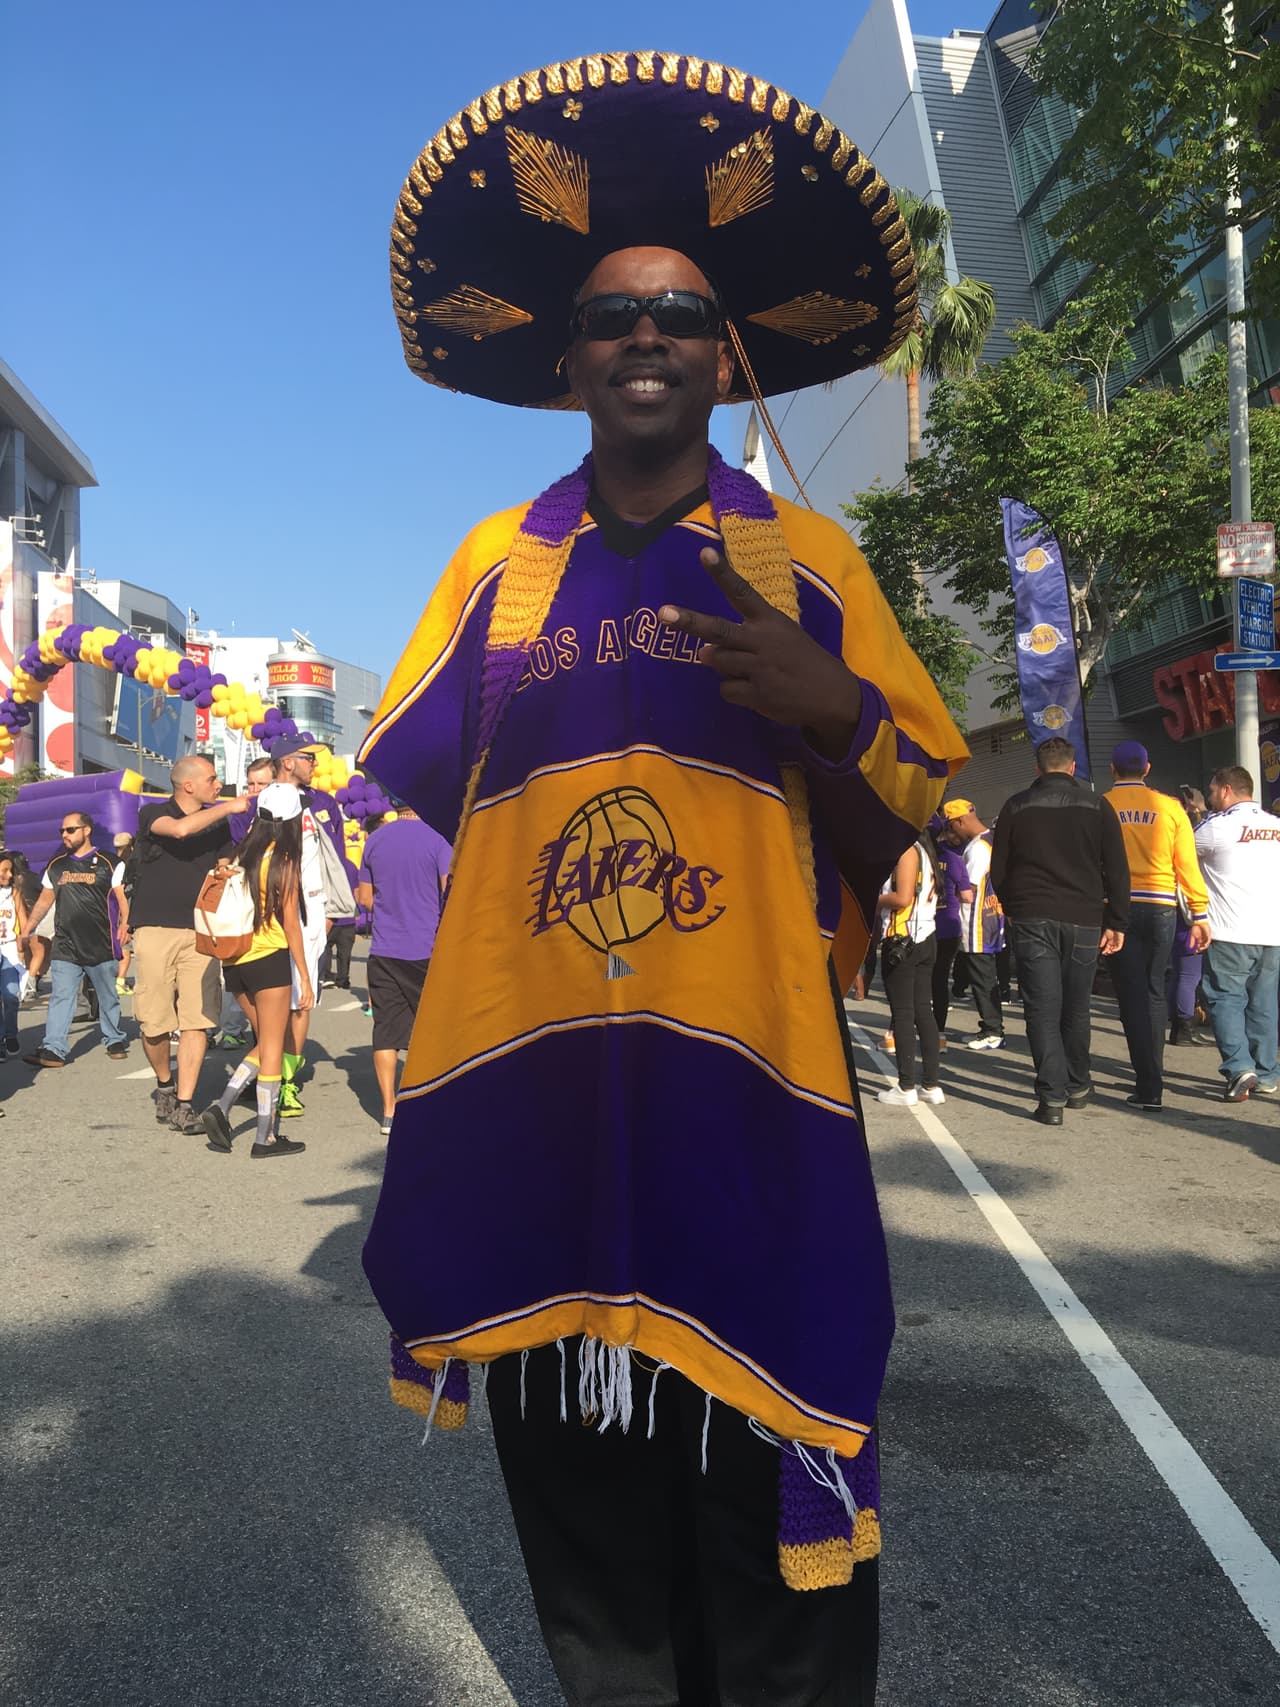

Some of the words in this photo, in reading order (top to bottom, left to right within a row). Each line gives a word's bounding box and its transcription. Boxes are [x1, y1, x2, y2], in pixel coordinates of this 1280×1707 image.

[1220, 534, 1235, 548] NO
[1238, 534, 1272, 544] STOPPING
[1225, 550, 1244, 559] ANY
[1248, 549, 1268, 558] TIME
[1240, 583, 1271, 602] ELECTRIC
[1242, 599, 1270, 617] VEHICLE
[1240, 614, 1273, 633] CHARGING
[1243, 631, 1271, 648] STATION
[1153, 643, 1236, 741] STA
[1119, 810, 1157, 825] RYANT
[525, 835, 727, 937] LAKERS
